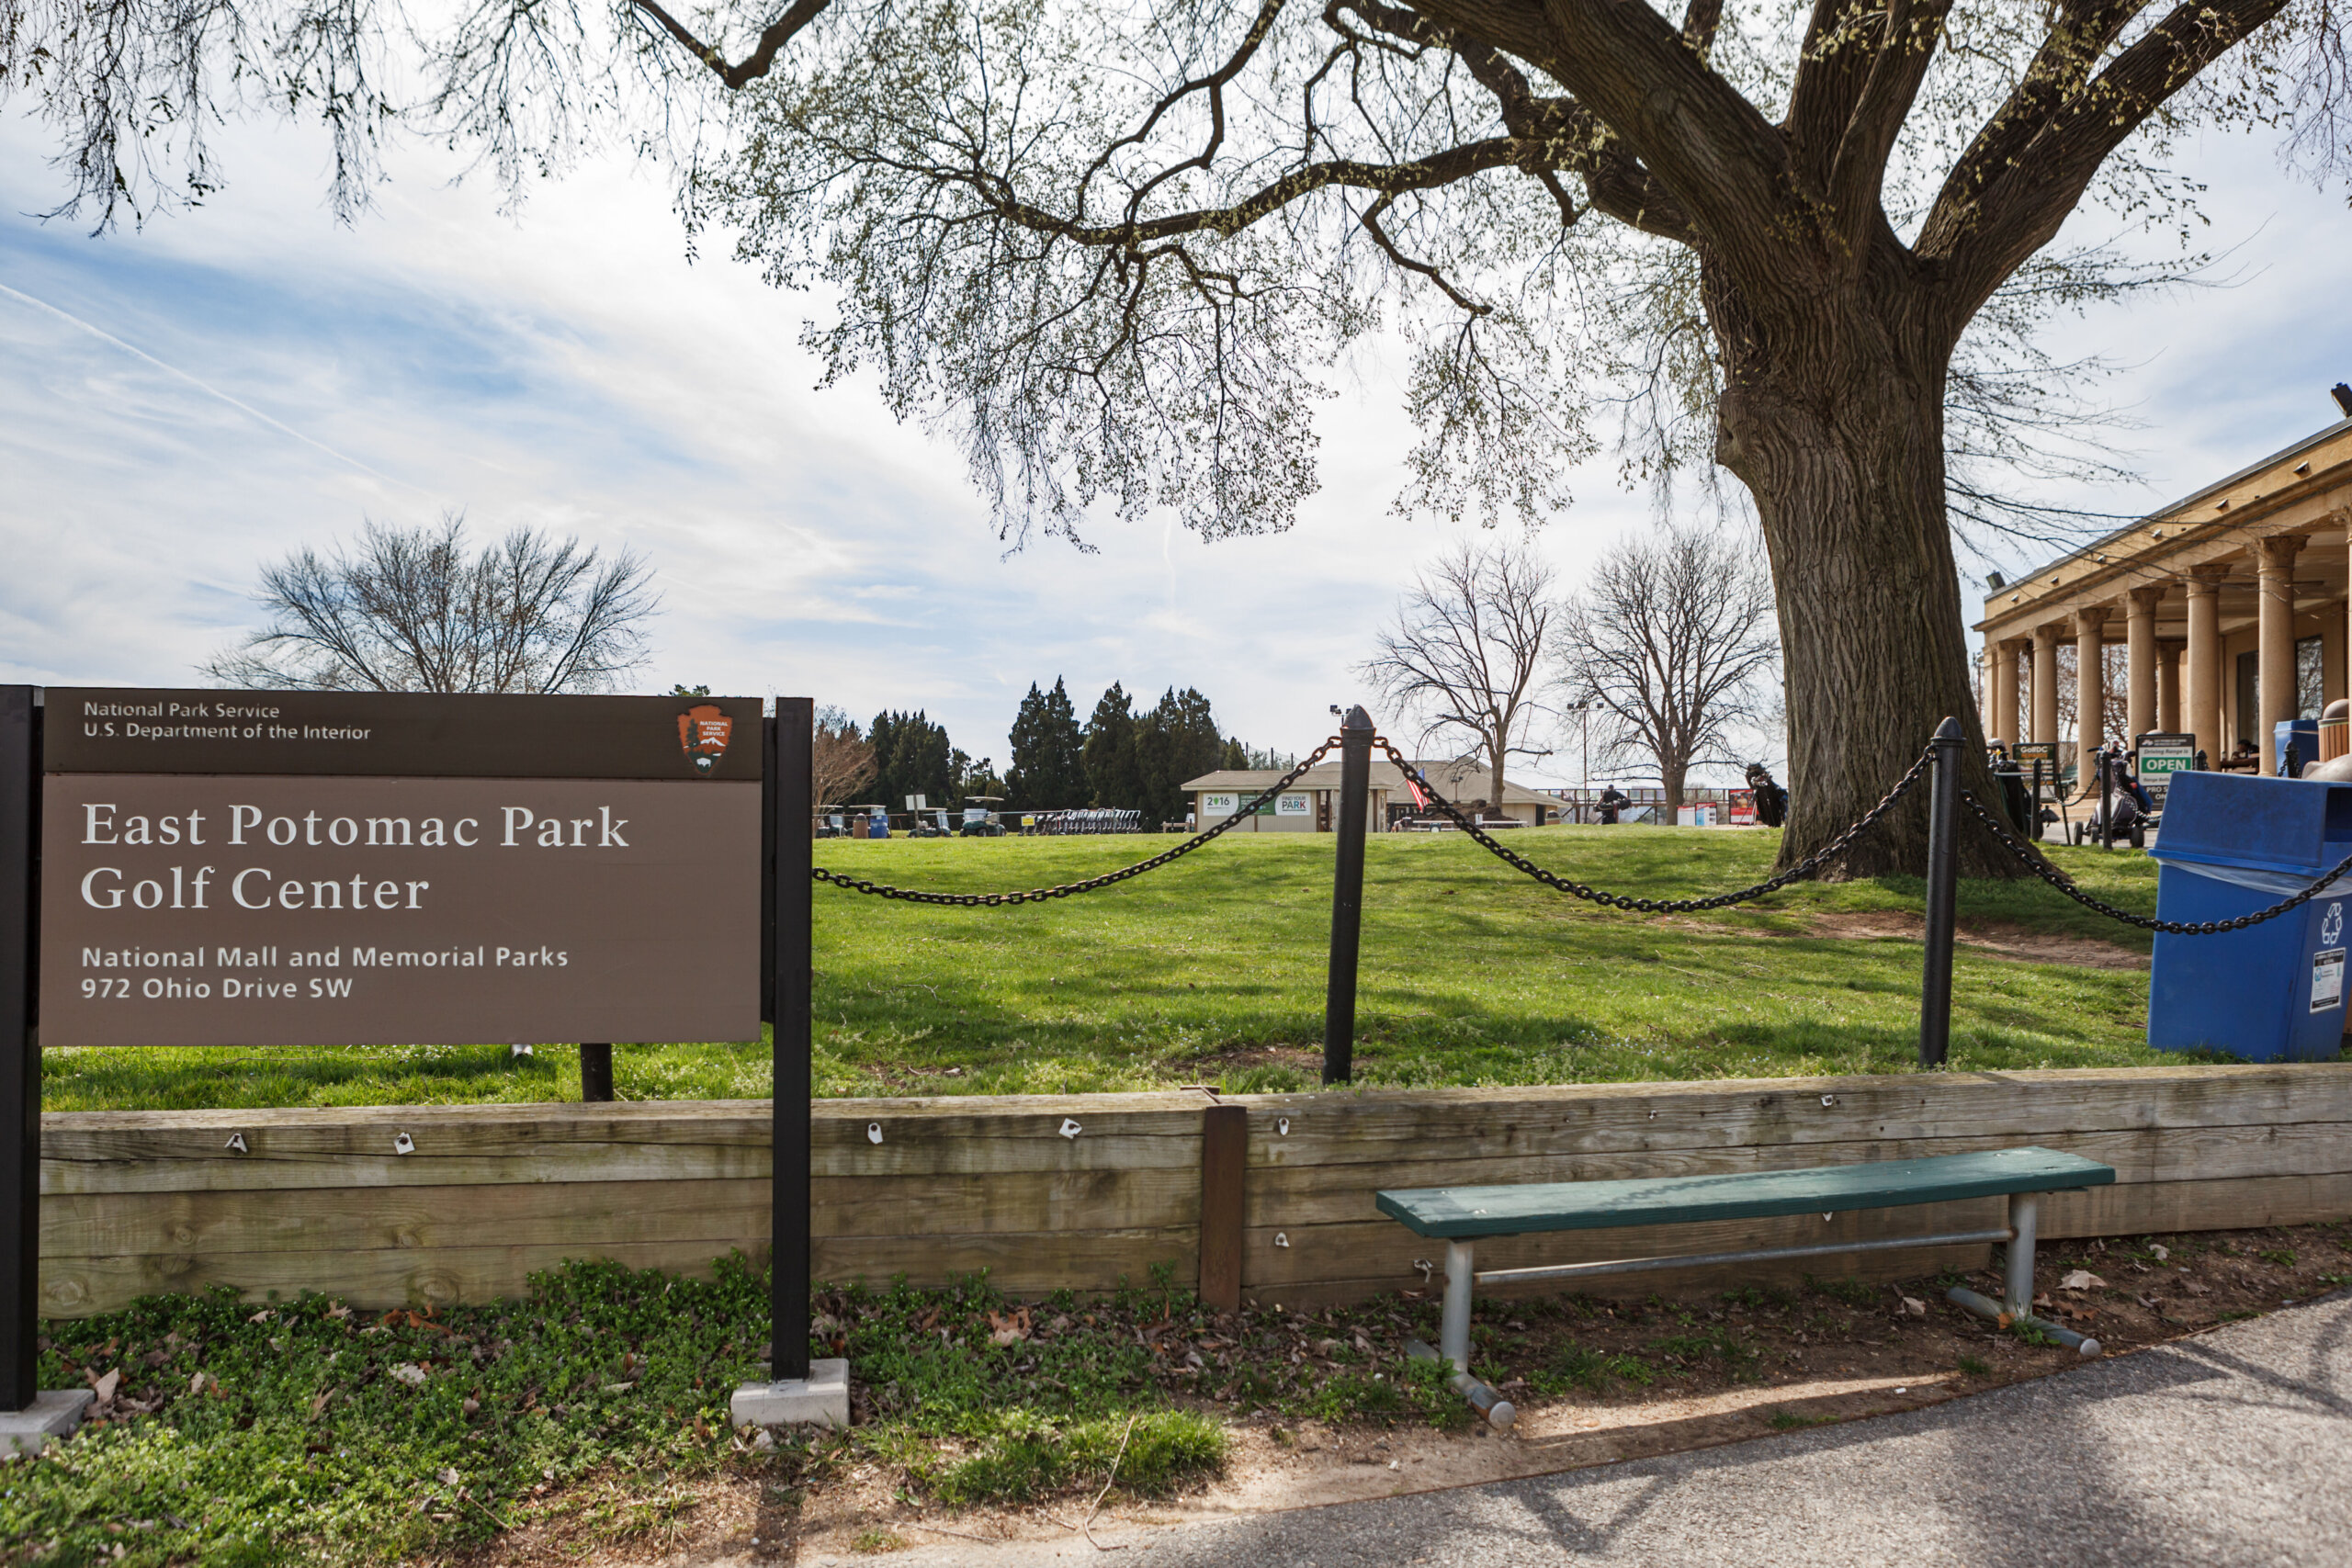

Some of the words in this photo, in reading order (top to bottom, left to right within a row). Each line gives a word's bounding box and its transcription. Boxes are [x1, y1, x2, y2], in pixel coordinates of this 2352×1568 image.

[85, 702, 163, 716] National
[169, 703, 209, 717] Park
[215, 703, 280, 718] Service
[85, 722, 119, 737] U.S.
[126, 723, 238, 740] Department
[243, 724, 263, 739] of
[268, 724, 299, 739] the
[304, 725, 371, 739] Interior
[2146, 759, 2186, 770] OPEN
[81, 803, 207, 845] East
[227, 805, 479, 847] Potomac
[500, 806, 629, 848] Park
[81, 865, 216, 909] Golf
[232, 867, 430, 910] Center
[82, 946, 204, 967] National
[217, 945, 277, 967] Mall
[288, 946, 340, 967] and
[352, 945, 484, 967] Memorial
[496, 945, 568, 967] Parks
[81, 977, 130, 999] 972
[142, 976, 211, 998] Ohio
[222, 977, 298, 998] Drive
[309, 977, 353, 998] SW
